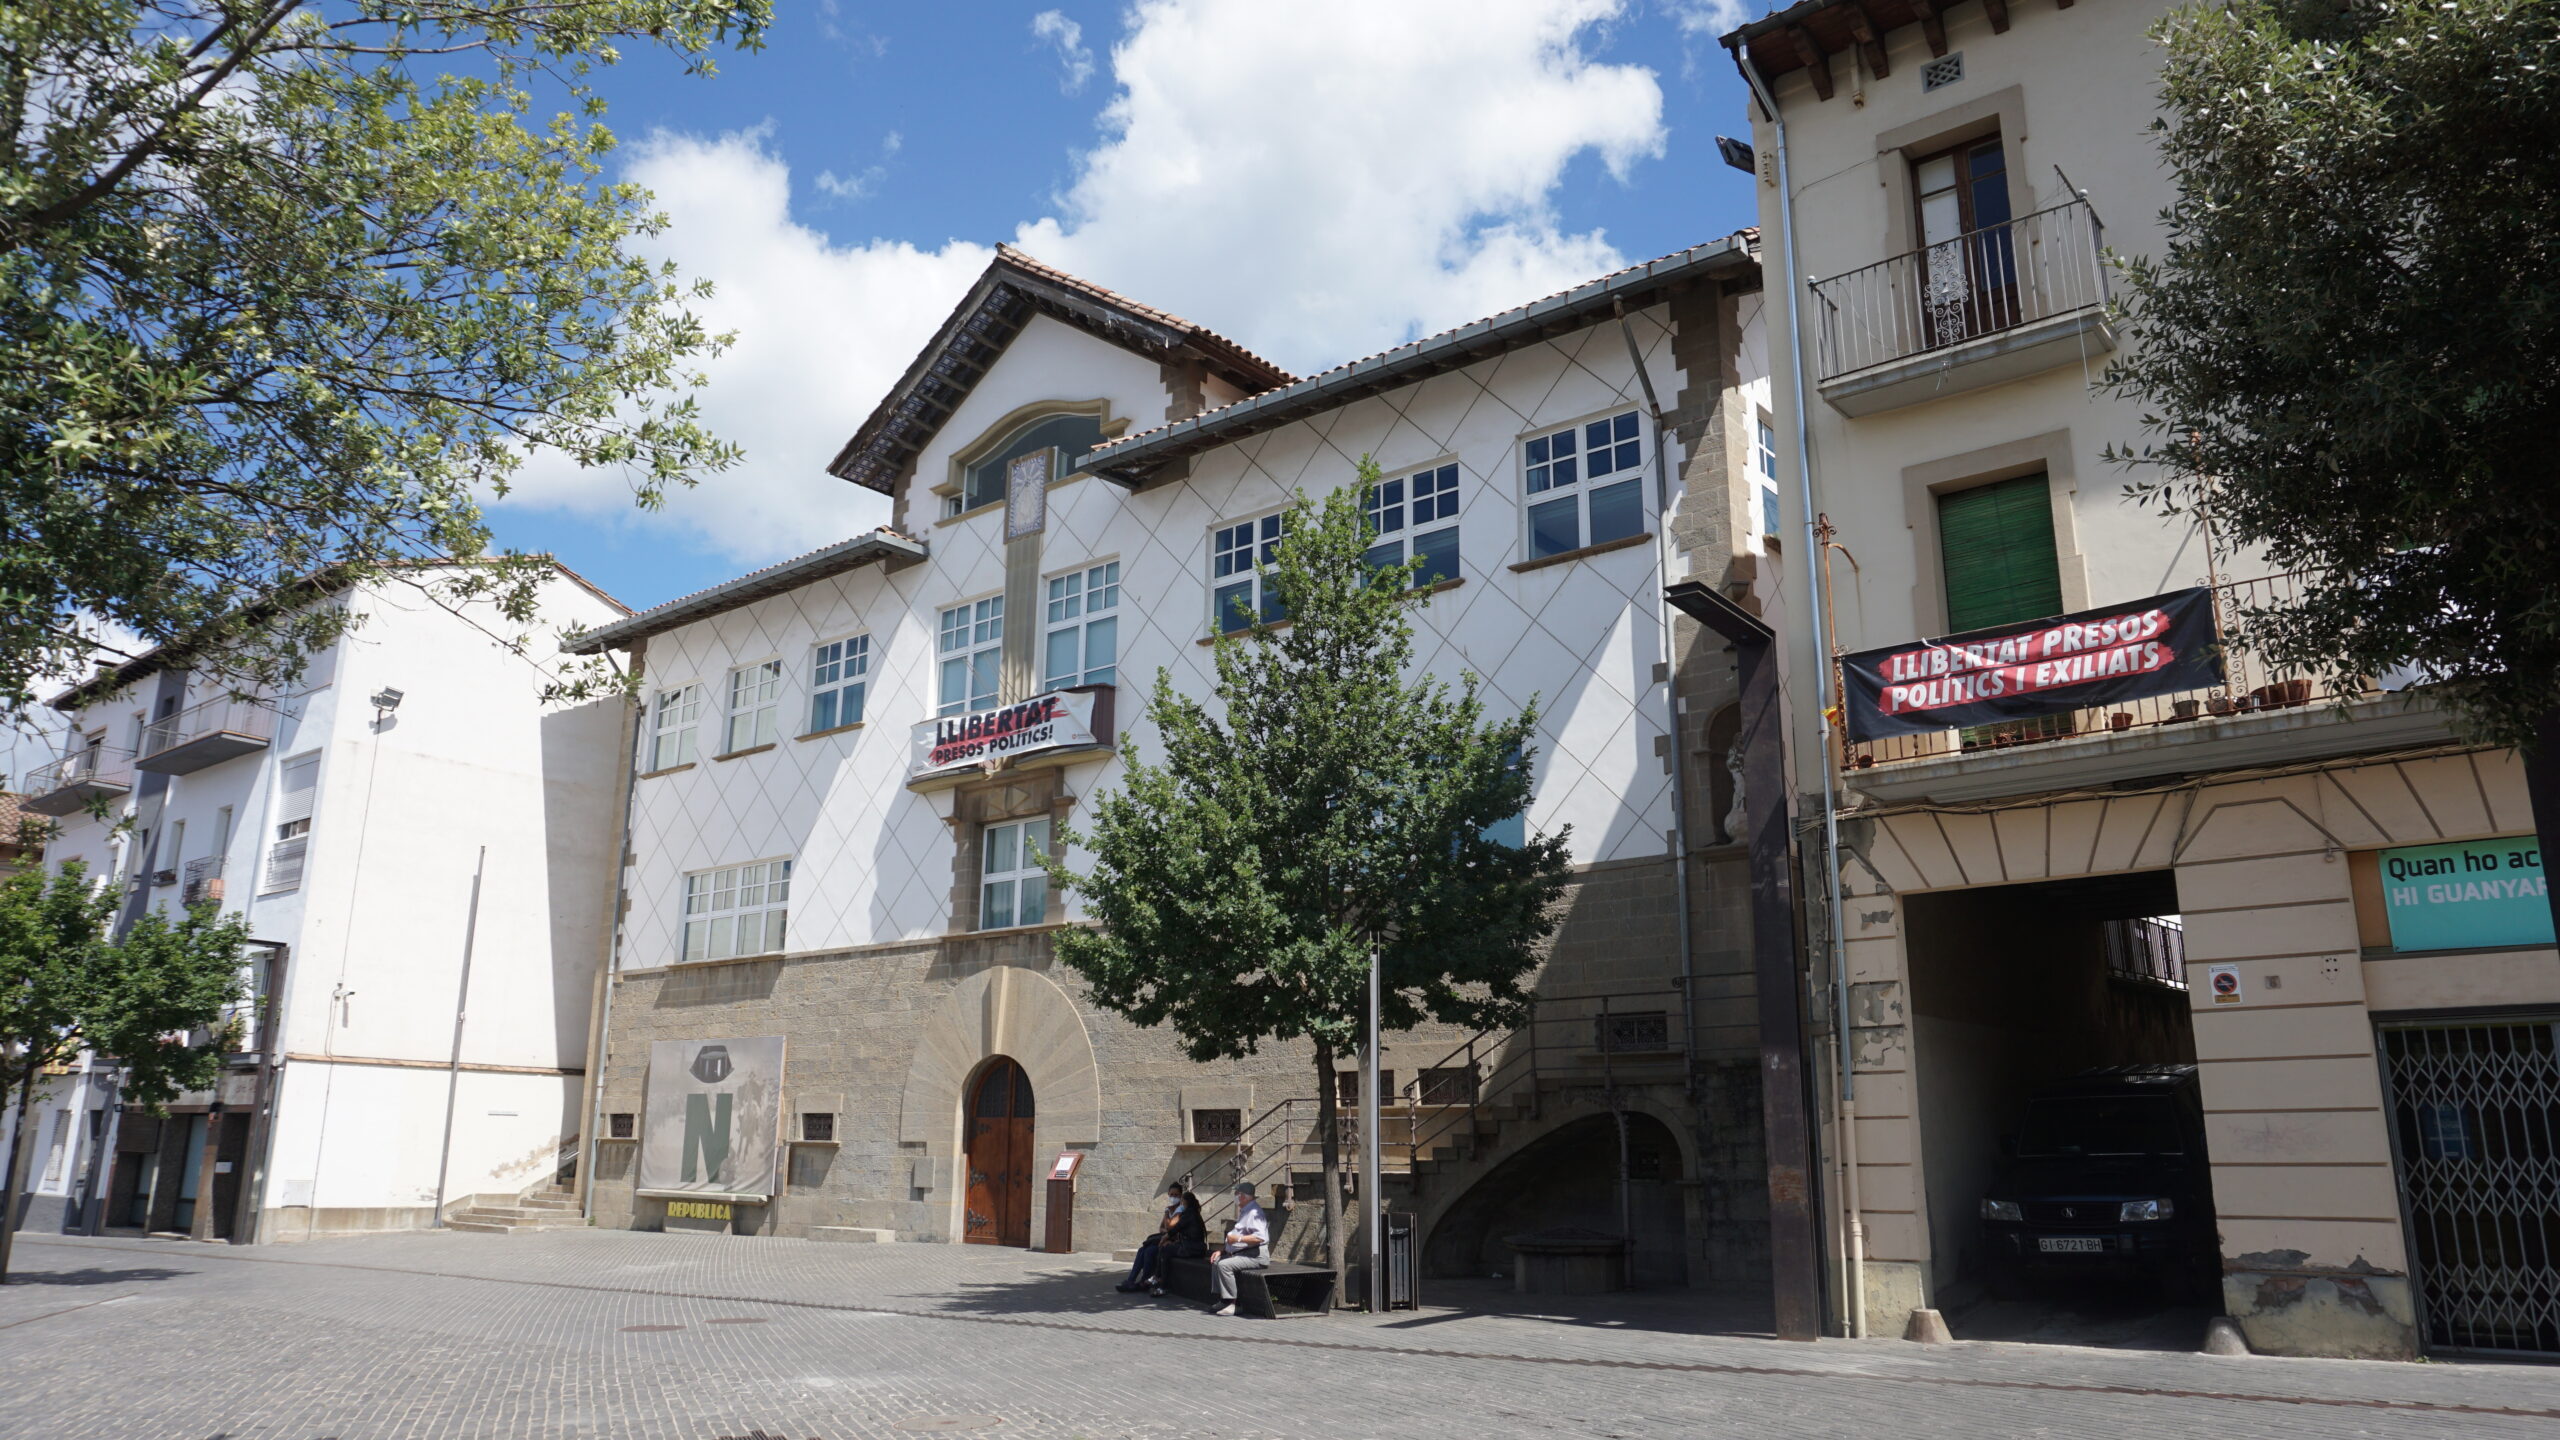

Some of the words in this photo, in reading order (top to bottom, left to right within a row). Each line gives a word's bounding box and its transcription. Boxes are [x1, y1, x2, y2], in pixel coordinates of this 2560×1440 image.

[1892, 634, 2032, 683] LLIBERTAT
[2043, 609, 2159, 654] PRESOS
[1891, 672, 2005, 712] POLÍTICS
[2016, 667, 2025, 692] I
[2036, 641, 2159, 687] EXILIATS
[936, 696, 1057, 747] LLIBERTAT
[935, 741, 984, 764] PRESOS
[2388, 857, 2456, 882] Quan
[2464, 850, 2498, 872] ho
[2392, 886, 2419, 906] HI
